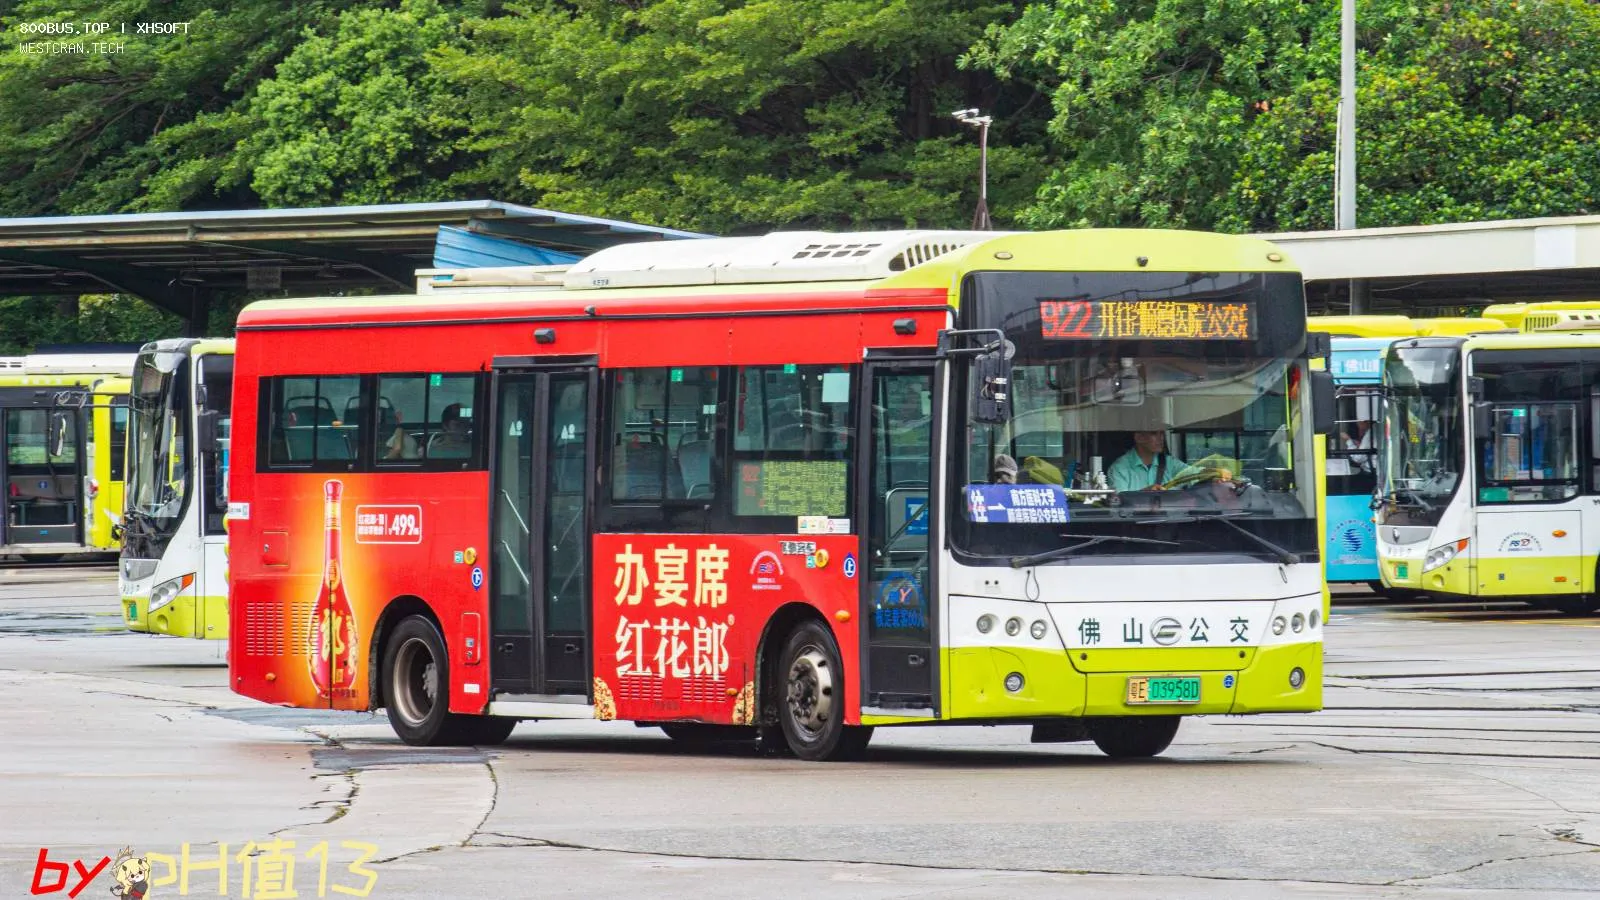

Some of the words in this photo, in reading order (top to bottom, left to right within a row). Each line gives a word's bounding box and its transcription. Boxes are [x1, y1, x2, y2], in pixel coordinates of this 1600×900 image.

[1040, 301, 1093, 338] 922
[614, 543, 729, 608] 办宴席
[615, 614, 729, 681] 红花郎
